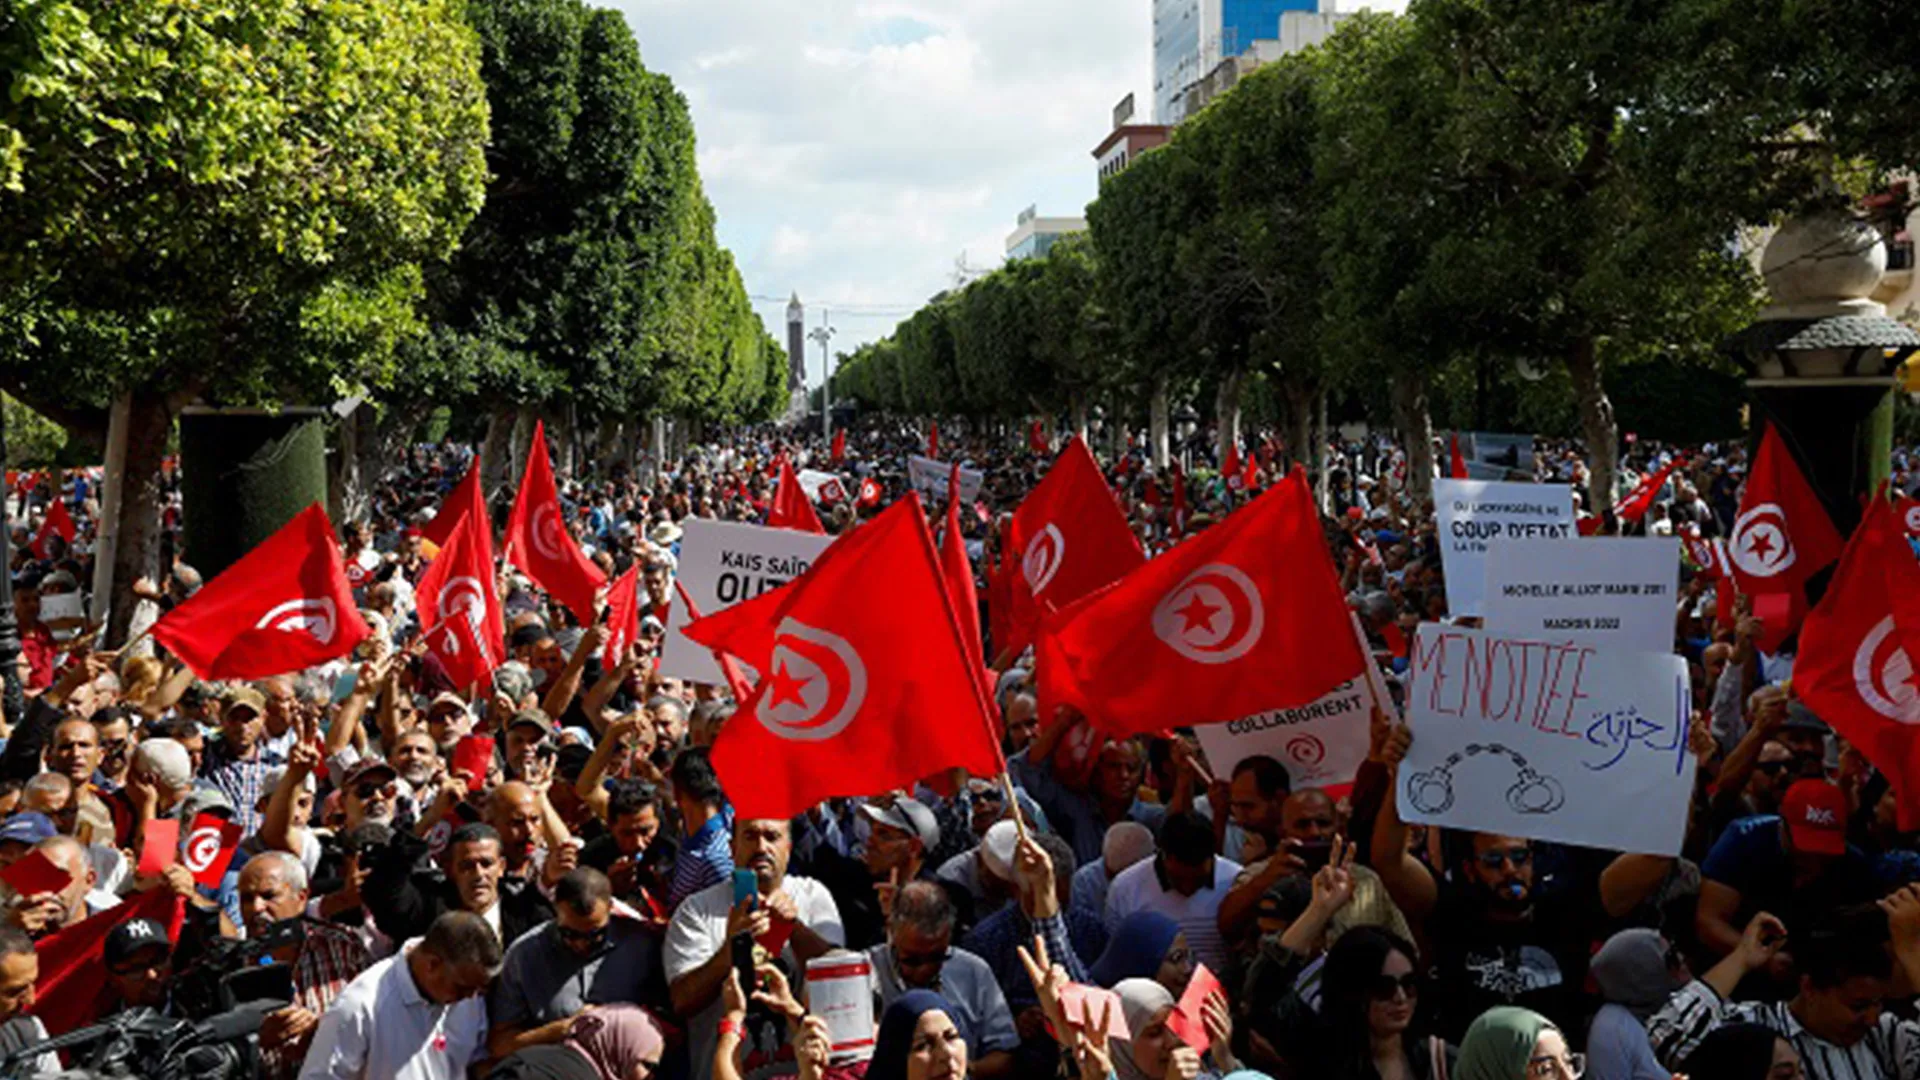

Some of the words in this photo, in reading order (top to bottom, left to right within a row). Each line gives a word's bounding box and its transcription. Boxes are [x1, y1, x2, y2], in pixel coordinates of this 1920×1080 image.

[1451, 520, 1502, 539] COUP
[721, 551, 763, 572] KAIS
[1503, 584, 1560, 597] MICHELLE
[1543, 618, 1591, 630] MACRON
[1593, 617, 1620, 630] 2022
[1226, 693, 1363, 736] COLLABORENT
